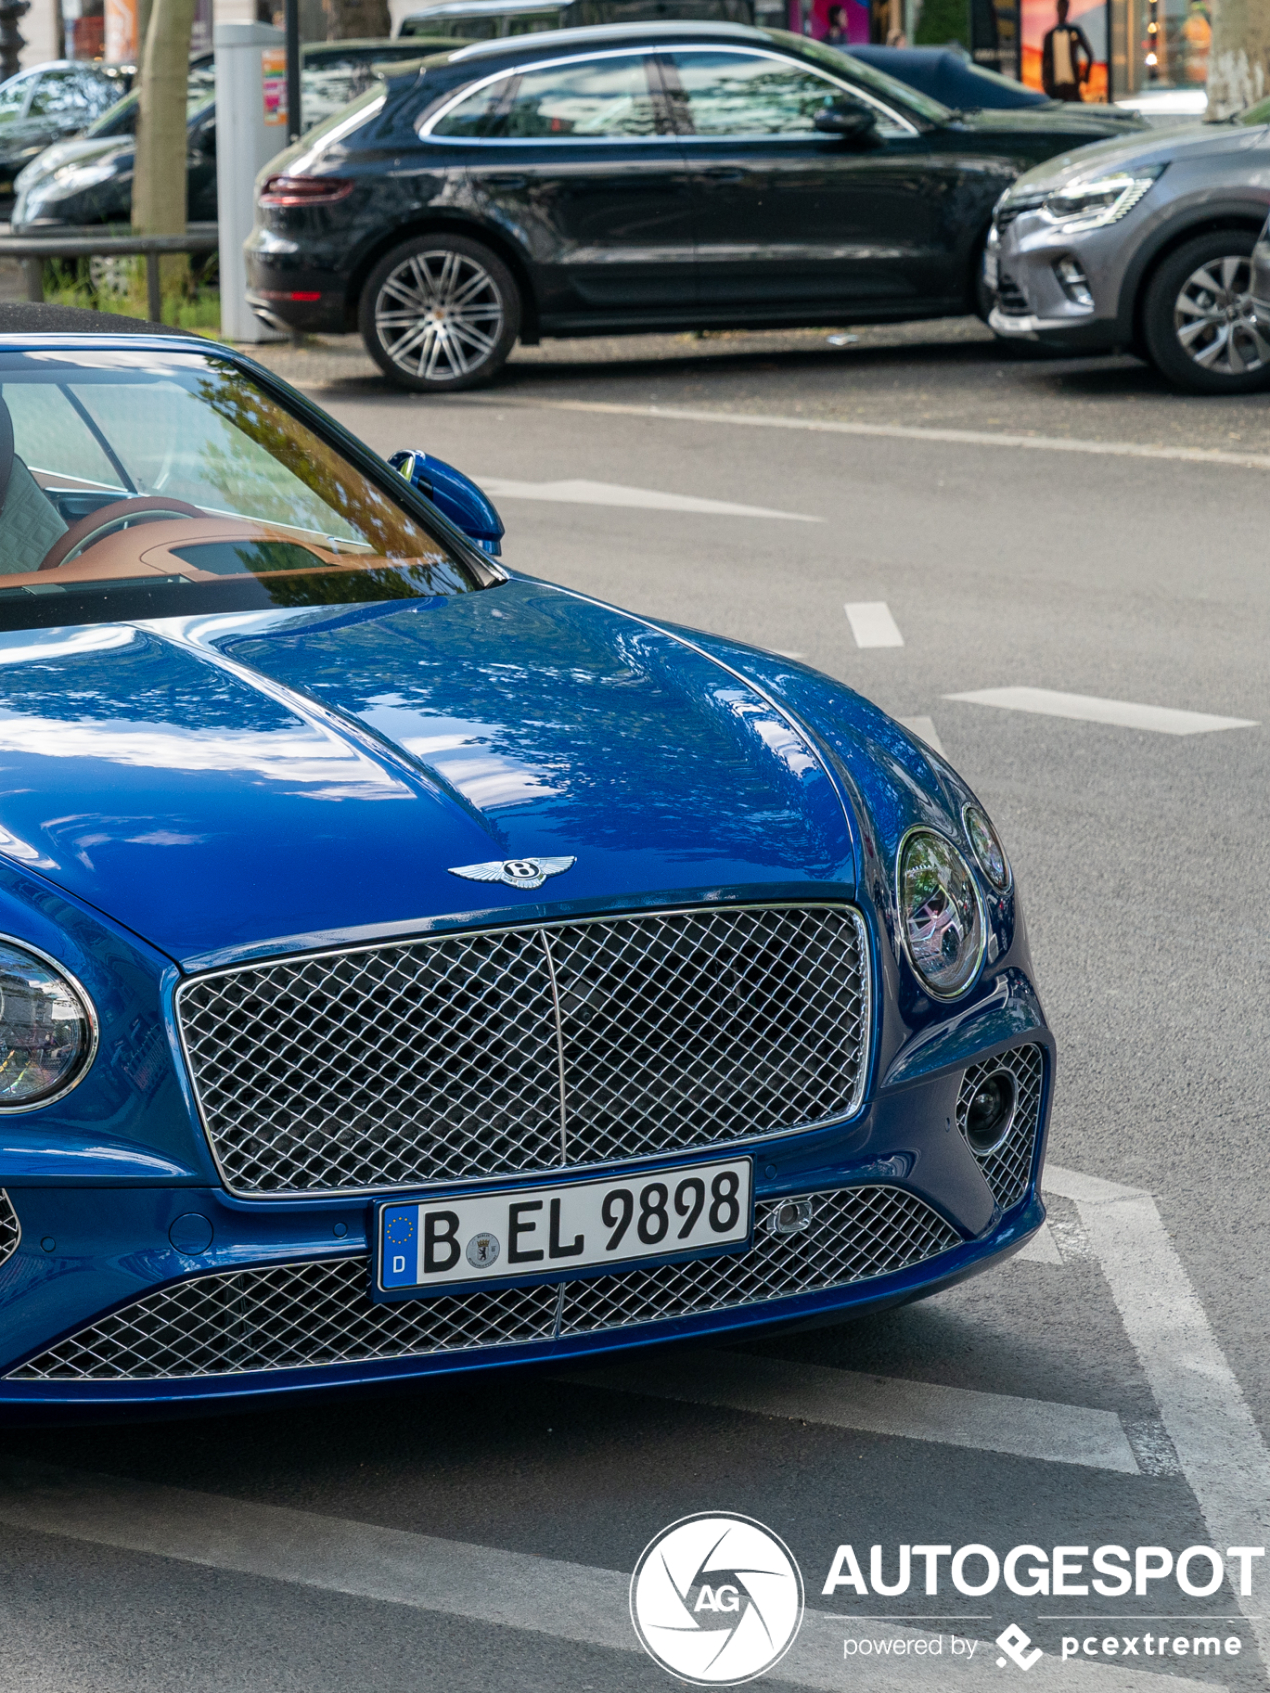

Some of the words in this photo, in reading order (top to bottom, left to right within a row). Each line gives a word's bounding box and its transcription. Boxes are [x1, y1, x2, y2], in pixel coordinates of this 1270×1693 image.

[423, 1210, 461, 1274] B
[508, 1198, 584, 1264] EL
[601, 1171, 740, 1251] 9898
[393, 1255, 406, 1273] D
